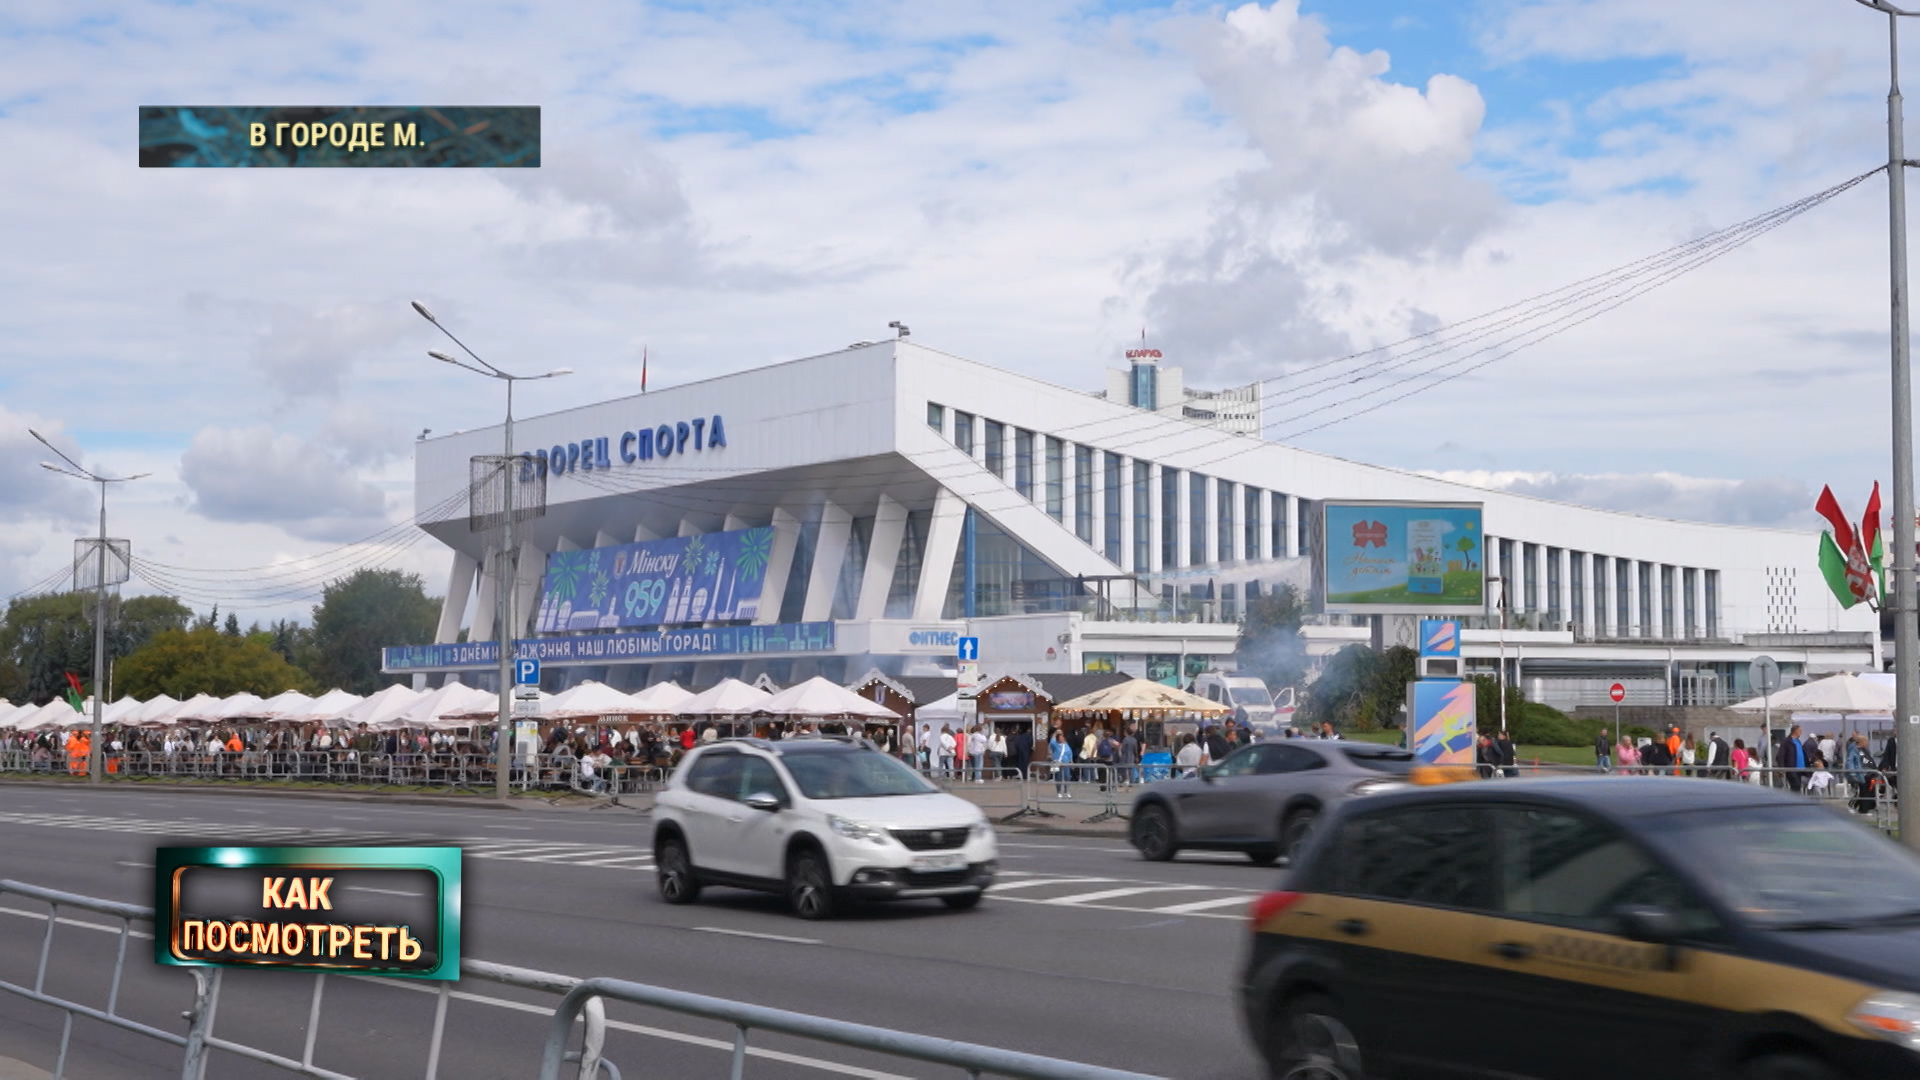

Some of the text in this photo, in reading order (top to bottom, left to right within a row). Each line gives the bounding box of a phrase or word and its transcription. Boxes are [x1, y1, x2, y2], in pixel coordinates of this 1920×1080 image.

[619, 414, 727, 464] СПОРТА
[626, 549, 680, 579] Мінску
[624, 578, 666, 618] 959
[452, 646, 459, 662] З
[460, 643, 490, 662] ДНЁМ
[577, 639, 604, 656] НАШ
[606, 636, 662, 655] ЛЮБІМЫ
[665, 632, 717, 652] ГОРАД!
[909, 630, 959, 646] ФИТНЕС
[521, 661, 535, 682] P
